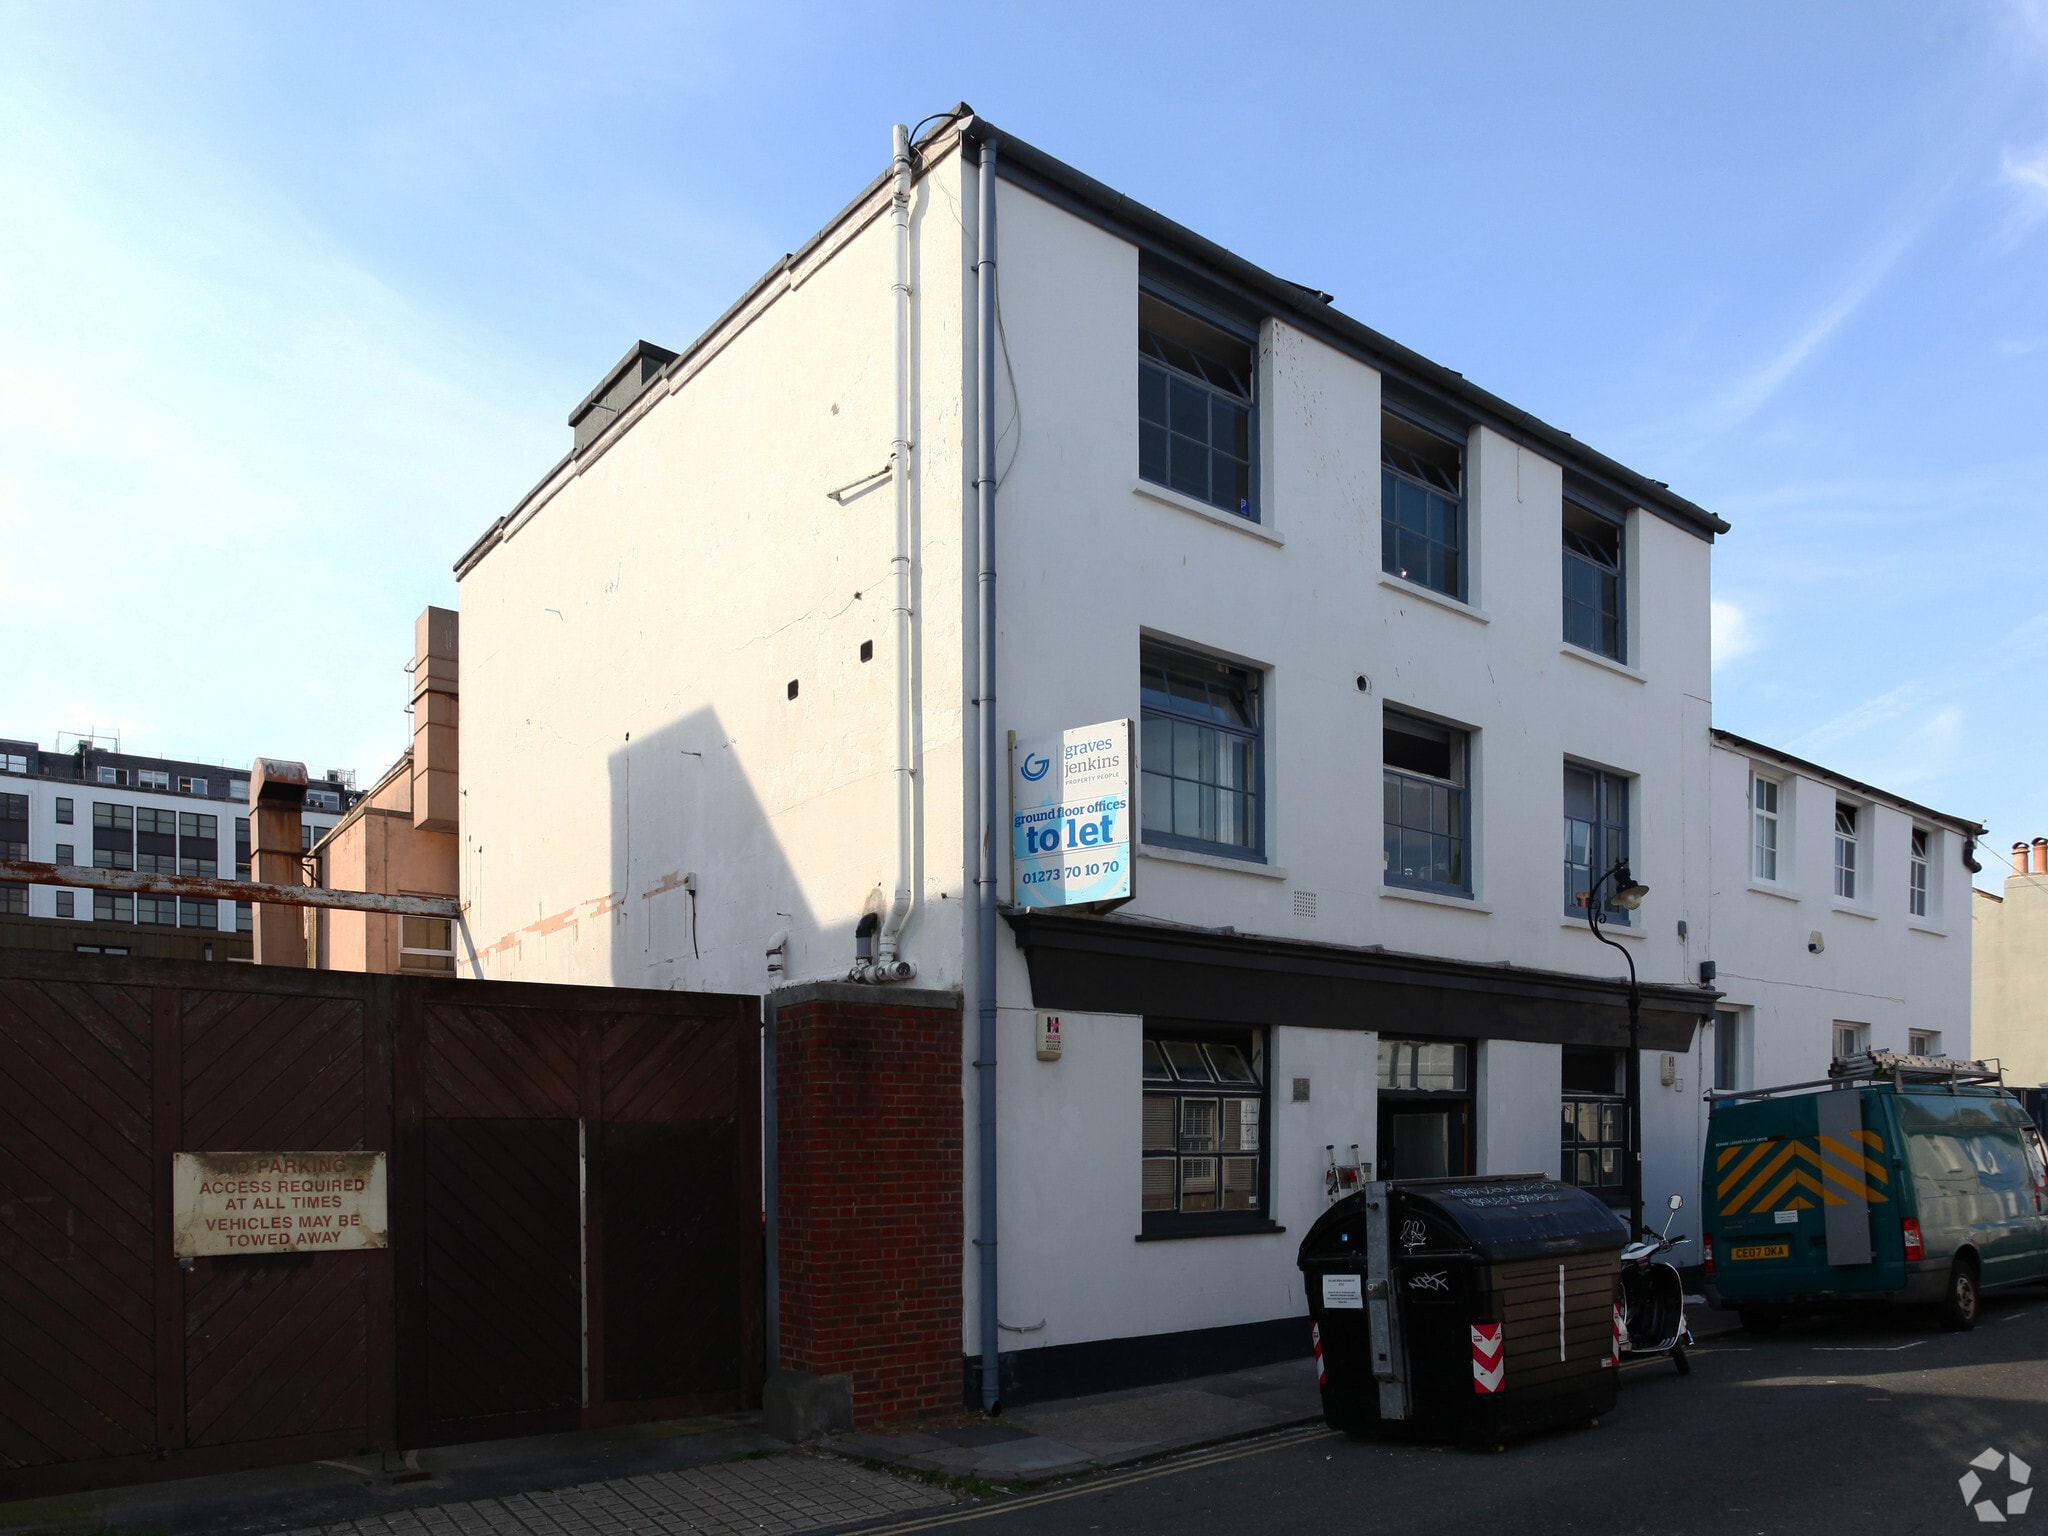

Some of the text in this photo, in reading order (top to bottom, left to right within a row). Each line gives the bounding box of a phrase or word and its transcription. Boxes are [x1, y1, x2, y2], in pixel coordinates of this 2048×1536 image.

[1065, 738, 1112, 760] graves
[1065, 755, 1120, 778] jenkins
[1065, 771, 1119, 786] PROPERTY PEOPLE
[1014, 799, 1126, 828] ground floor offices
[1026, 814, 1113, 854] to let
[1022, 860, 1119, 884] 01273 70 10 70
[257, 1158, 346, 1174] PARKING
[200, 1178, 365, 1194] ACCESS REQUIRED
[225, 1196, 342, 1210] AT ALL TIMES
[206, 1214, 361, 1231] VEHICLES MAY BE
[226, 1231, 341, 1247] TOWED AWAY
